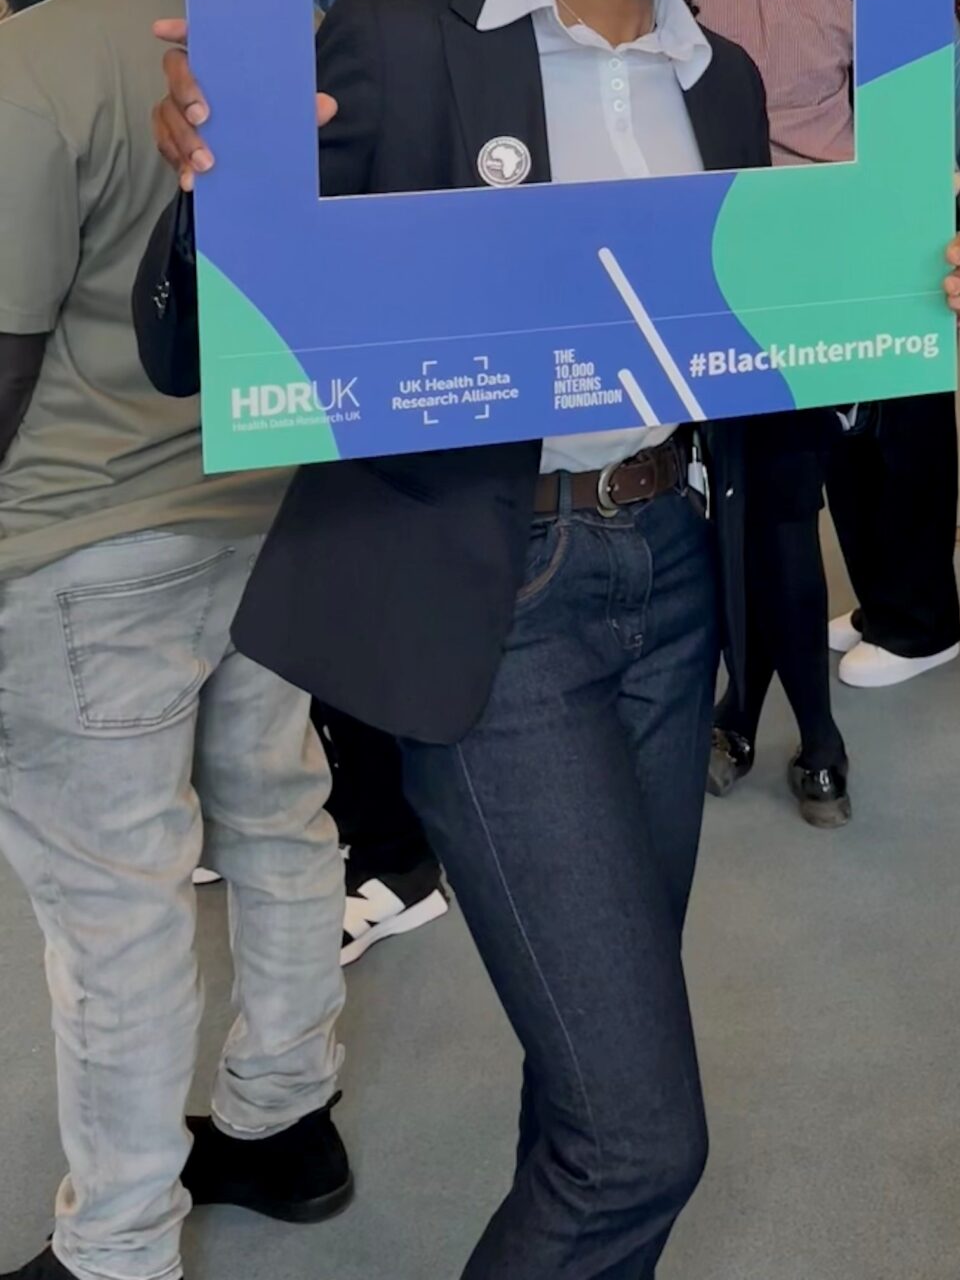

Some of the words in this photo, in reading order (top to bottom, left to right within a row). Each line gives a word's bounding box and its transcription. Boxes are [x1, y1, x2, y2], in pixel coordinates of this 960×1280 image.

[553, 348, 576, 365] THE
[689, 332, 940, 377] #BlackInternProg
[555, 361, 594, 380] 10,000
[399, 379, 422, 393] UK
[425, 375, 474, 391] Health
[477, 372, 511, 387] Data
[554, 376, 602, 394] INTERNS
[392, 391, 459, 410] Research
[461, 388, 519, 403] Alliance
[554, 389, 622, 410] FOUNDATION
[232, 419, 268, 432] Health
[270, 418, 294, 429] Data
[295, 412, 343, 426] Research
[345, 410, 361, 422] UK
